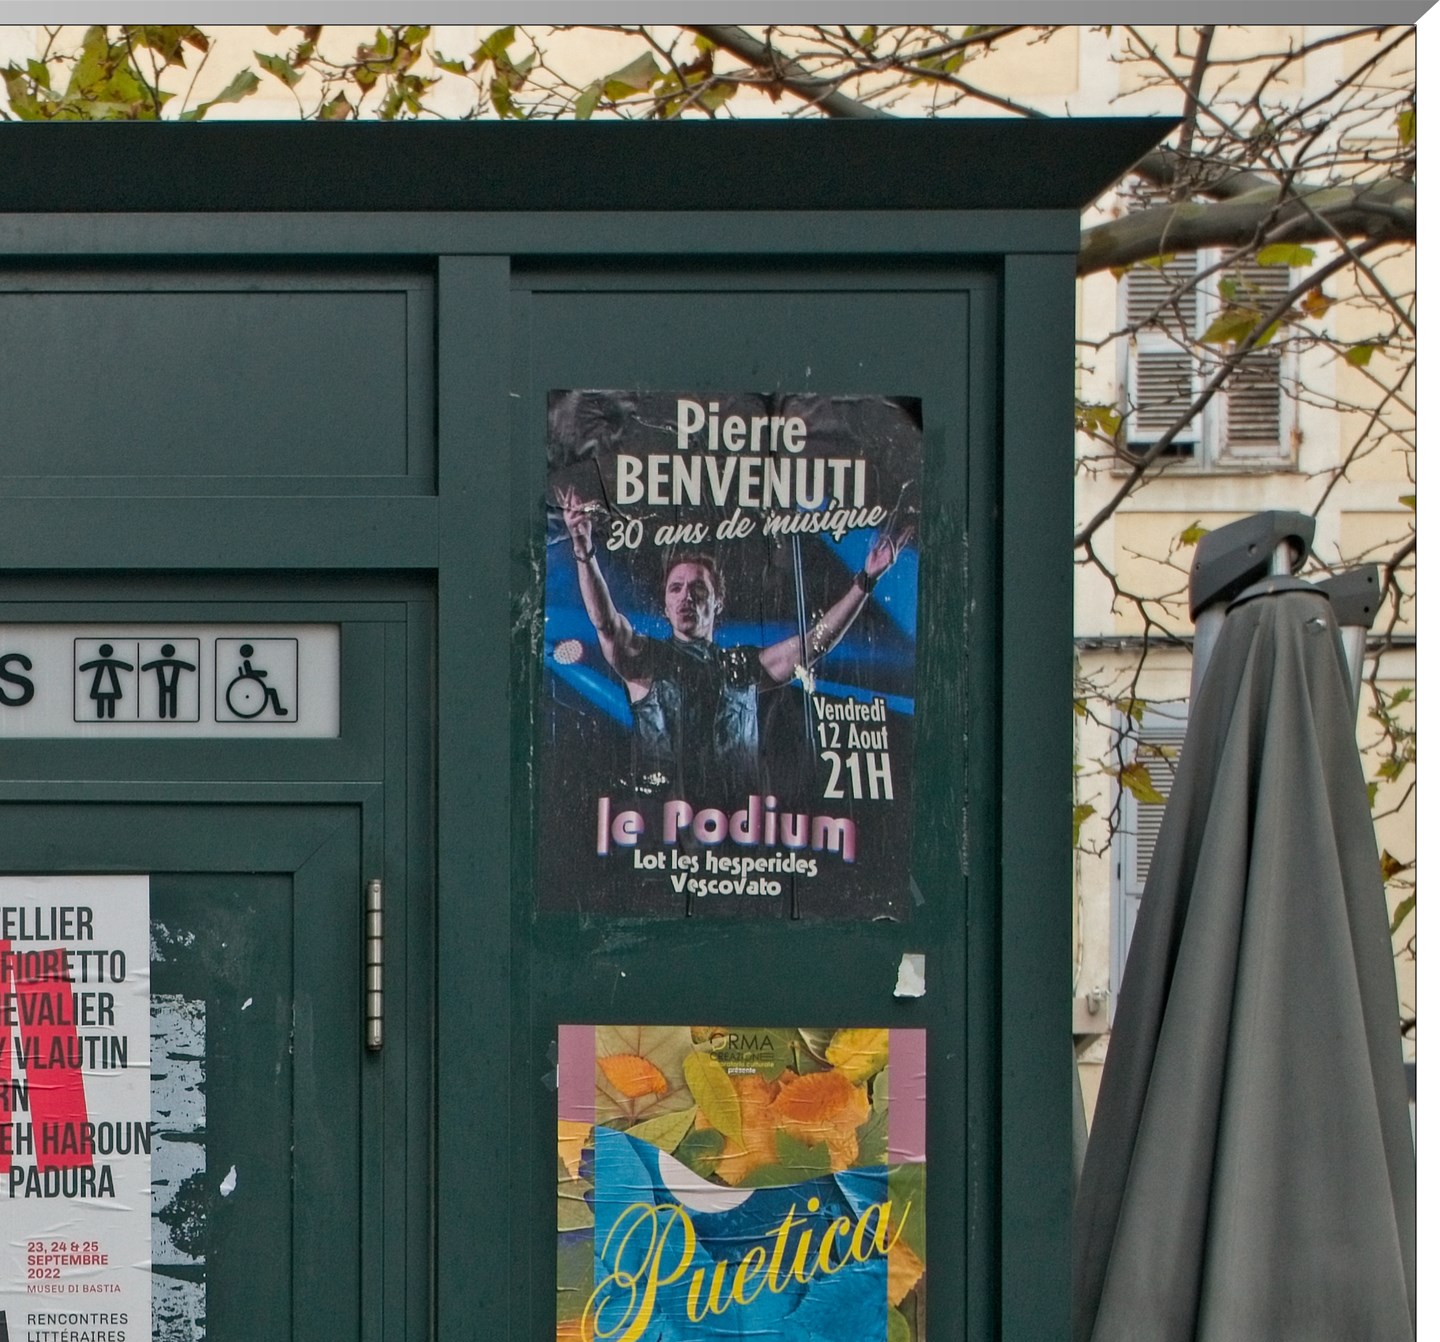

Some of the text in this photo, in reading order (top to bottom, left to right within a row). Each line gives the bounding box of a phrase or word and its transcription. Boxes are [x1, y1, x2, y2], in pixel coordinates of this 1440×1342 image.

[676, 398, 807, 453] Pierre
[616, 454, 866, 511] BENVENUTI
[606, 500, 887, 551] 30 ans de musique
[814, 698, 885, 722] Vendredi
[817, 724, 888, 749] 12 Aout
[820, 752, 894, 800] 21H
[663, 795, 856, 863] Podium
[634, 850, 818, 878] Lot les hesperides
[671, 873, 782, 897] Vescovato
[1, 950, 126, 983] FIORETTO
[15, 1035, 128, 1070] VLAUTIN
[42, 1121, 151, 1156] HAROUN
[9, 1164, 115, 1198] PADURA
[27, 1242, 99, 1254] 23, 24 & 25
[27, 1255, 109, 1266] SEPTEMBRE
[27, 1268, 61, 1279] 2022
[27, 1284, 121, 1294] MUSEU DI BASTIA
[27, 1313, 128, 1325] RENCONTRES
[27, 1328, 126, 1342] LITTÉRAIRES
